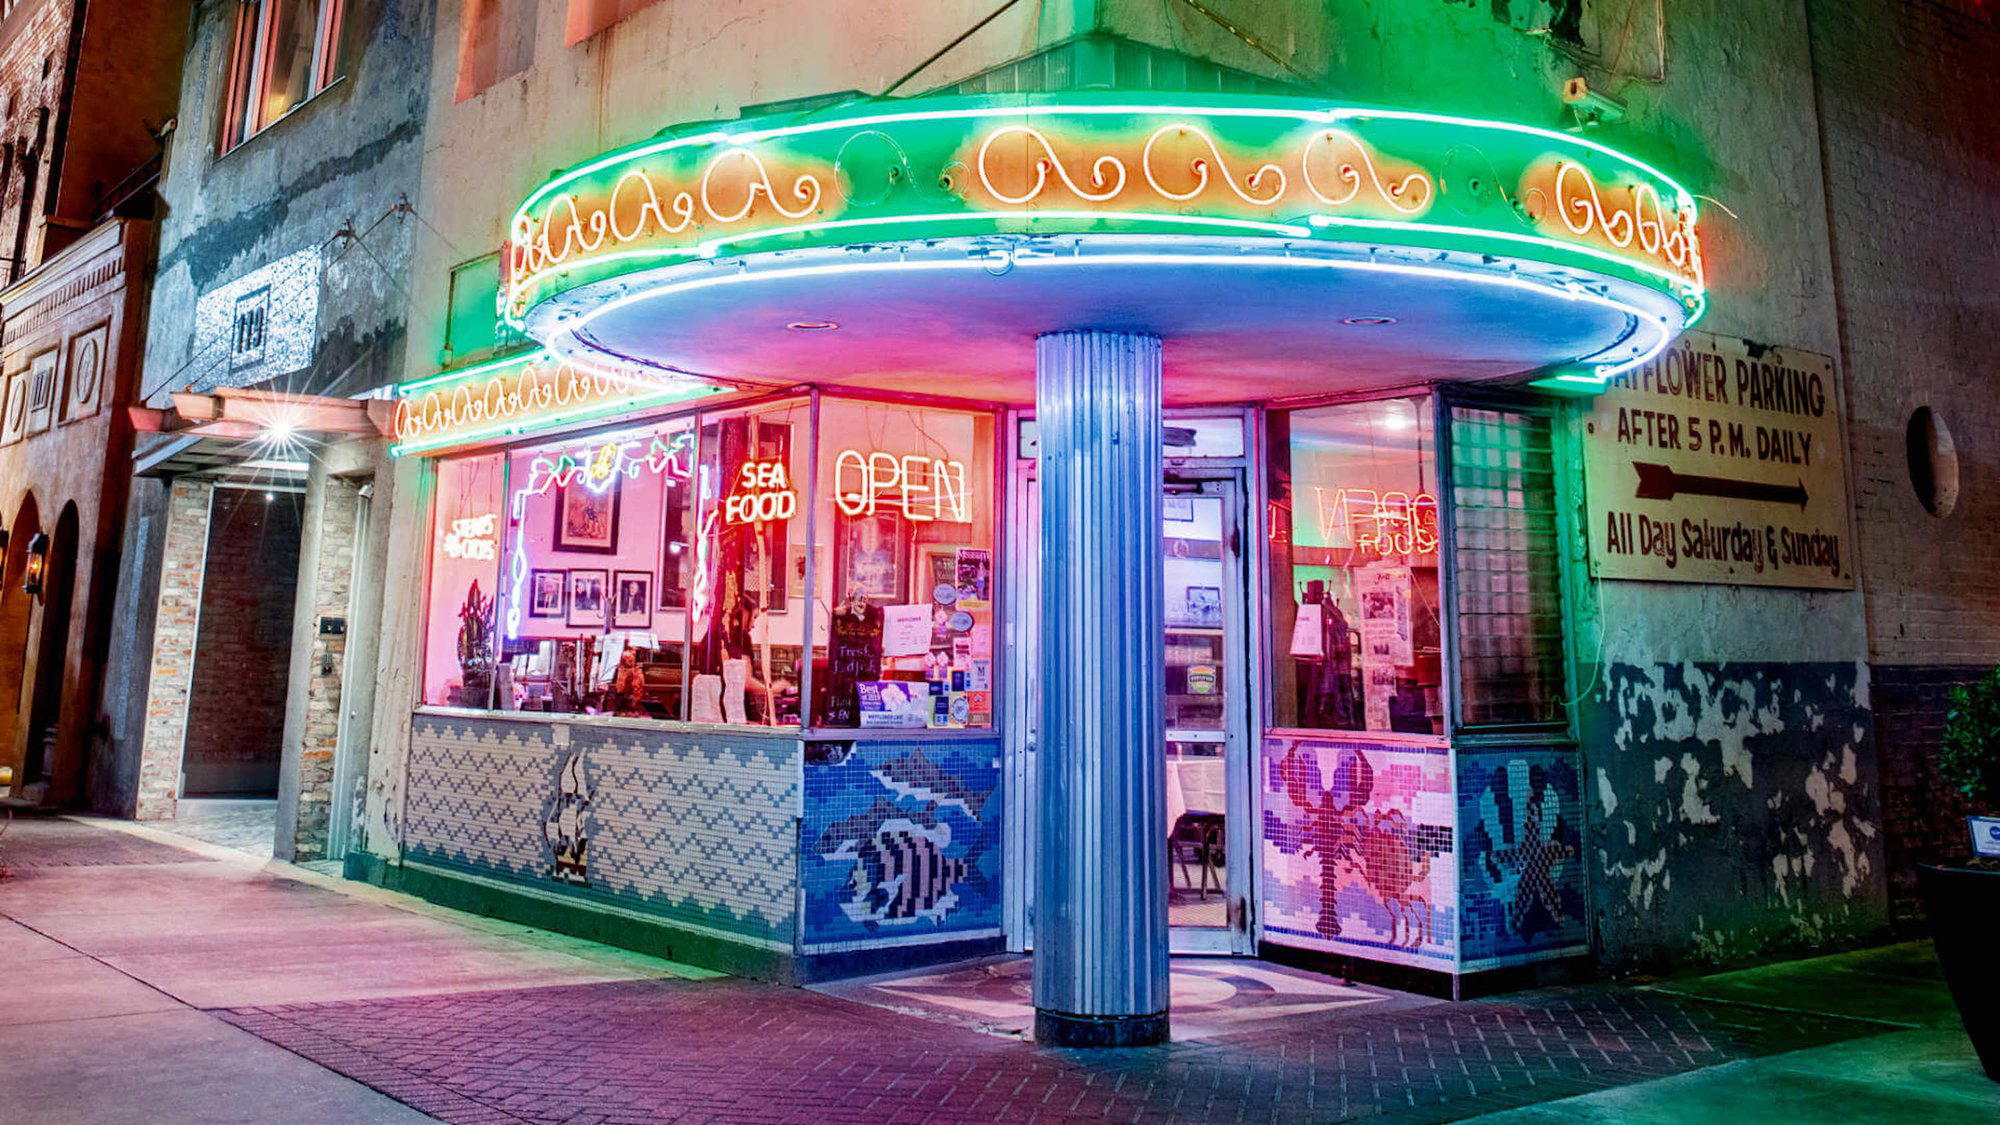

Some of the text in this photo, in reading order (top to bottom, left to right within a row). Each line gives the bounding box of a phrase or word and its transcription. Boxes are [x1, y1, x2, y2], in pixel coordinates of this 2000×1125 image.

[1607, 345, 1825, 418] AYFLOWER PARKING
[1617, 406, 1681, 450] AFTER
[1688, 417, 1702, 451] 5
[1756, 426, 1812, 466] DAILY
[725, 490, 797, 523] FOOD
[741, 462, 787, 489] SEA
[835, 449, 966, 524] OPEN
[1607, 511, 1839, 577] All Day Saturday & Sunday
